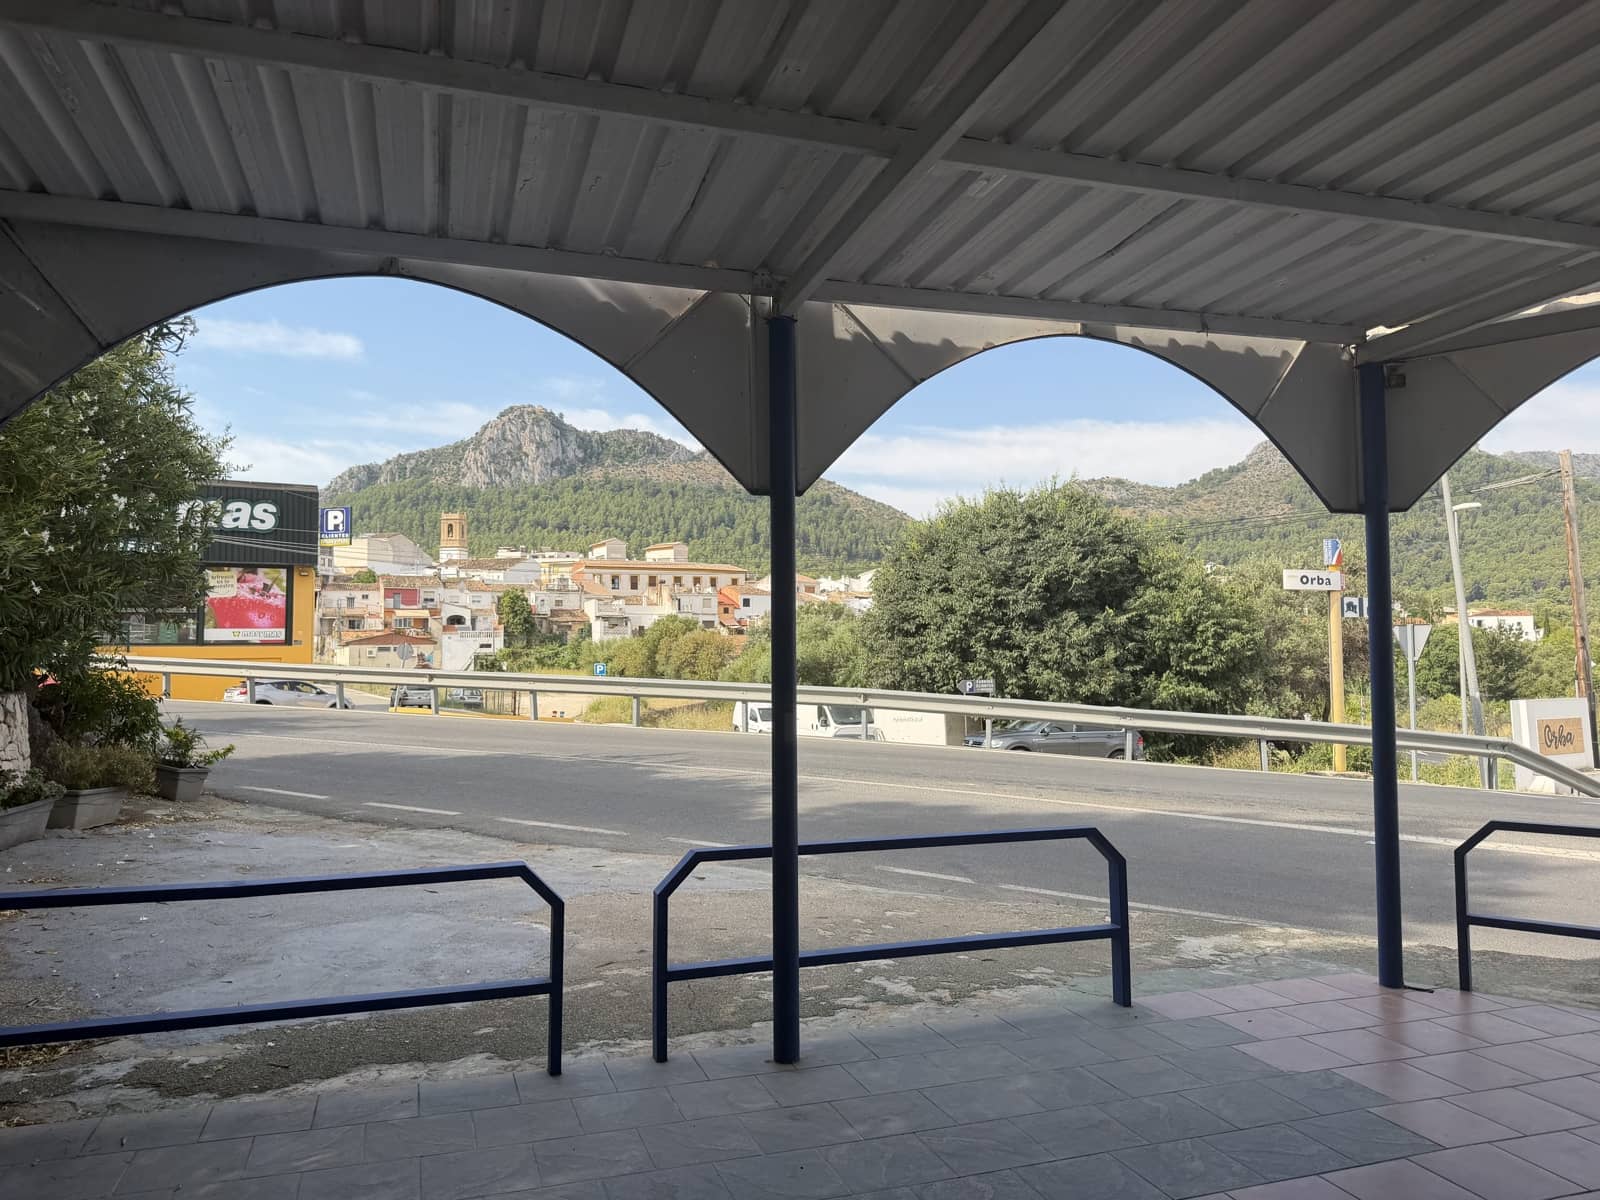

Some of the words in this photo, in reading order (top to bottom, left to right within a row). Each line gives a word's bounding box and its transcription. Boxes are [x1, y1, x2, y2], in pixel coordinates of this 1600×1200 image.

[327, 510, 343, 531] P
[1300, 575, 1331, 586] Orba
[596, 665, 604, 674] P
[966, 681, 973, 692] P
[1544, 724, 1575, 750] Orba
